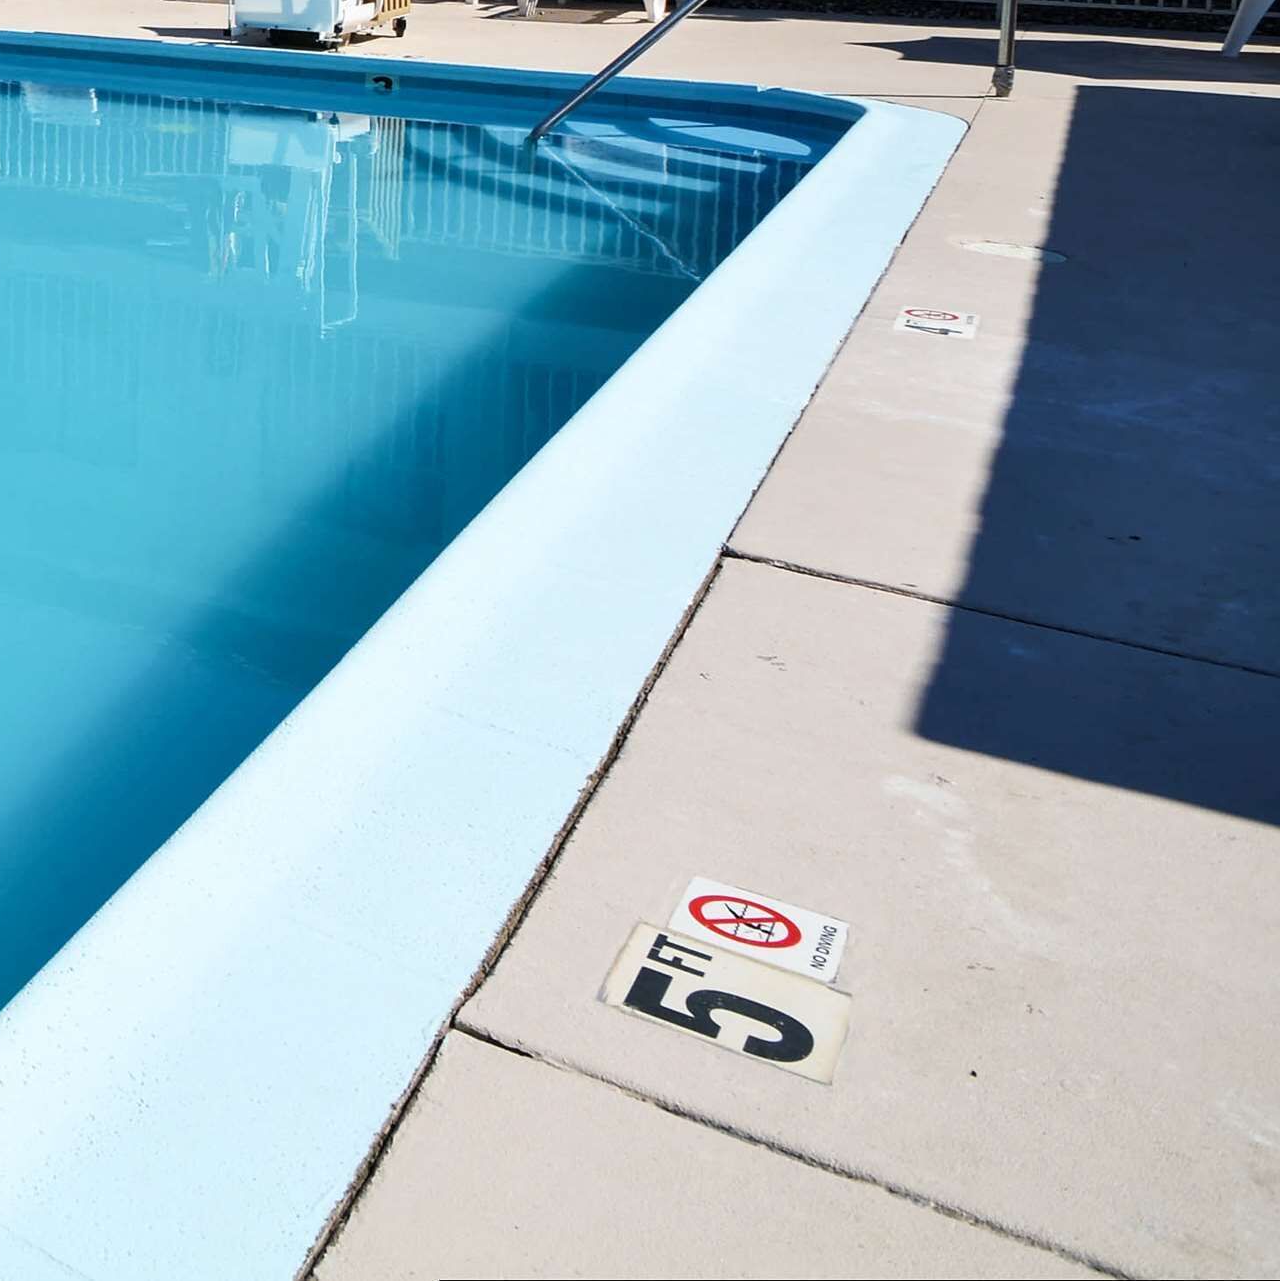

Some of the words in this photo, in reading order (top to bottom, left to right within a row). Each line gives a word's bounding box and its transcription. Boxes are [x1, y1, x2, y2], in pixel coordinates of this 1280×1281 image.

[646, 933, 713, 978] FT
[816, 925, 837, 955] DIVING
[810, 954, 827, 971] NO
[624, 966, 815, 1063] 5
